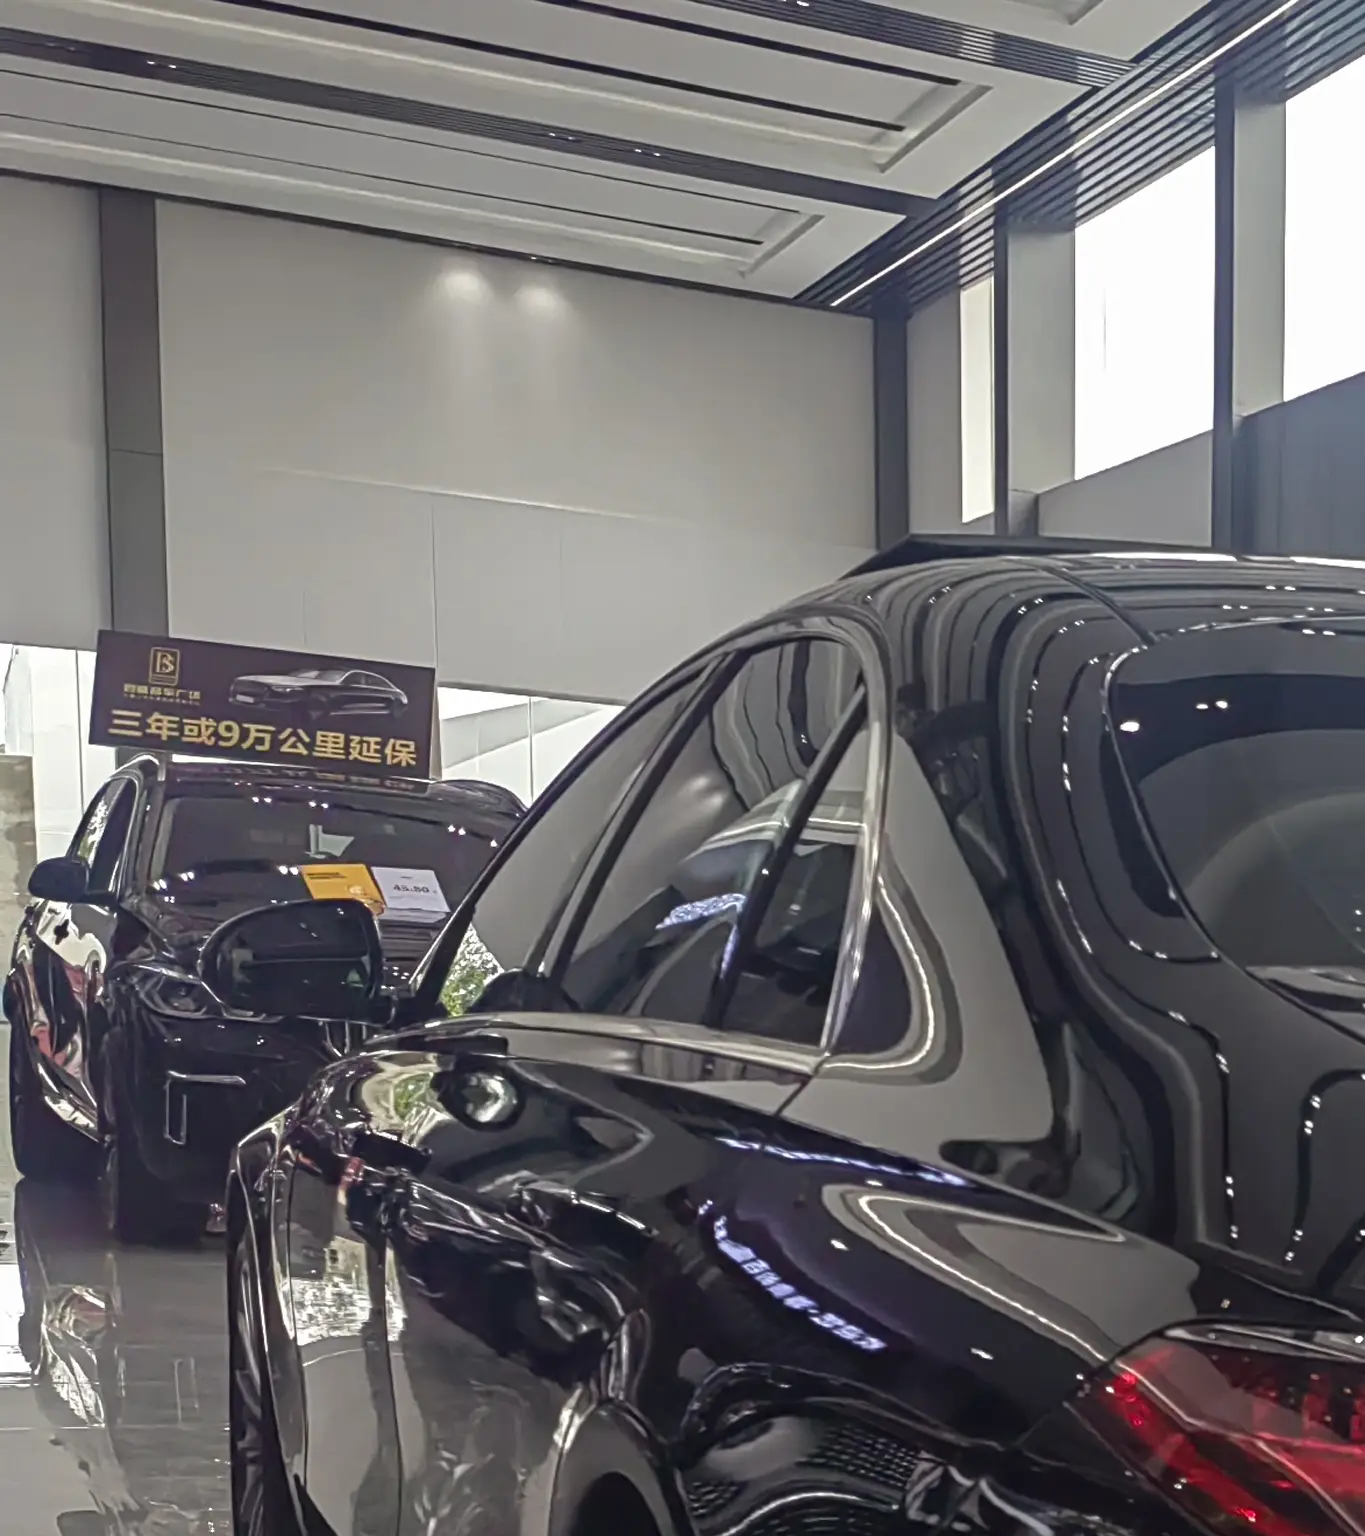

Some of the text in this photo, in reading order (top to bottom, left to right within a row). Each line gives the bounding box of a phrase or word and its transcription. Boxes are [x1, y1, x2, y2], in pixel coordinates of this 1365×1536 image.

[108, 709, 417, 767] 三年或9万公里延保
